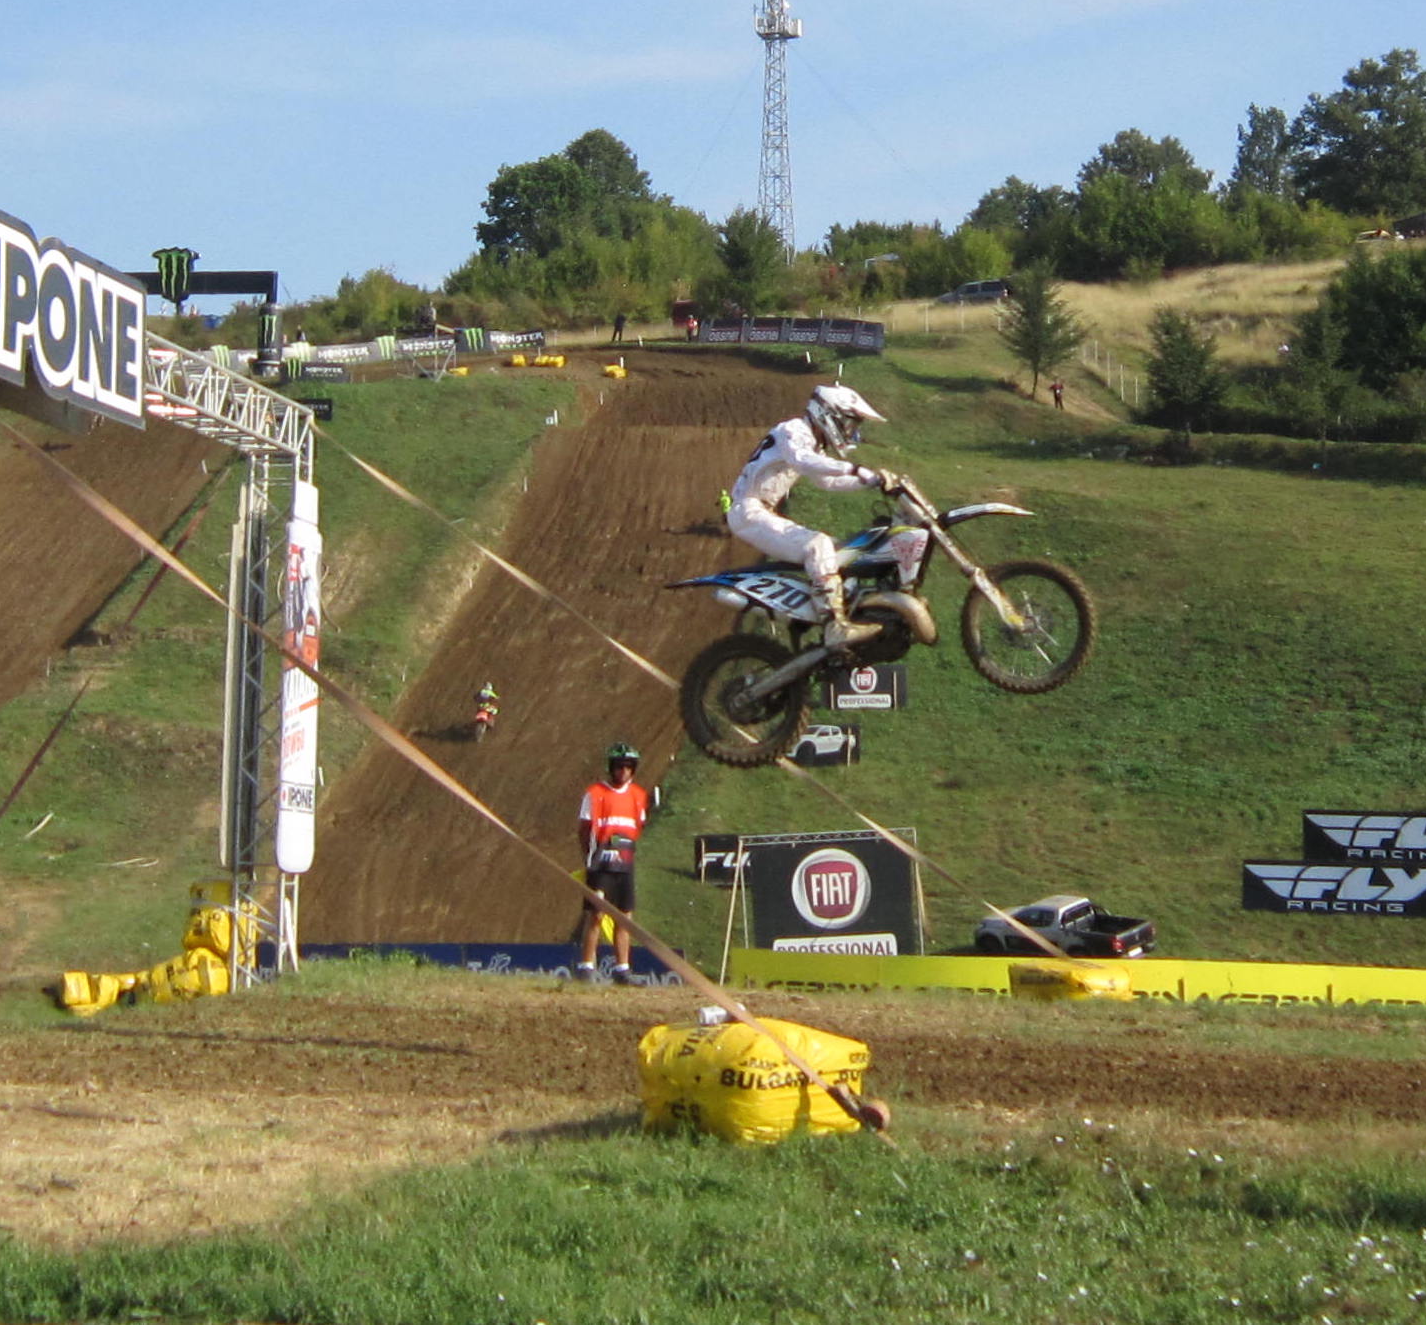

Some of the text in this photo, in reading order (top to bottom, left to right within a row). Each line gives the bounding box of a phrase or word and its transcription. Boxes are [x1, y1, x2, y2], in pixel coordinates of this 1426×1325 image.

[490, 332, 544, 344] MONSTER
[747, 577, 812, 610] 270
[288, 785, 313, 810] IPONE
[810, 872, 854, 907] FIAT
[1286, 900, 1406, 913] RACING
